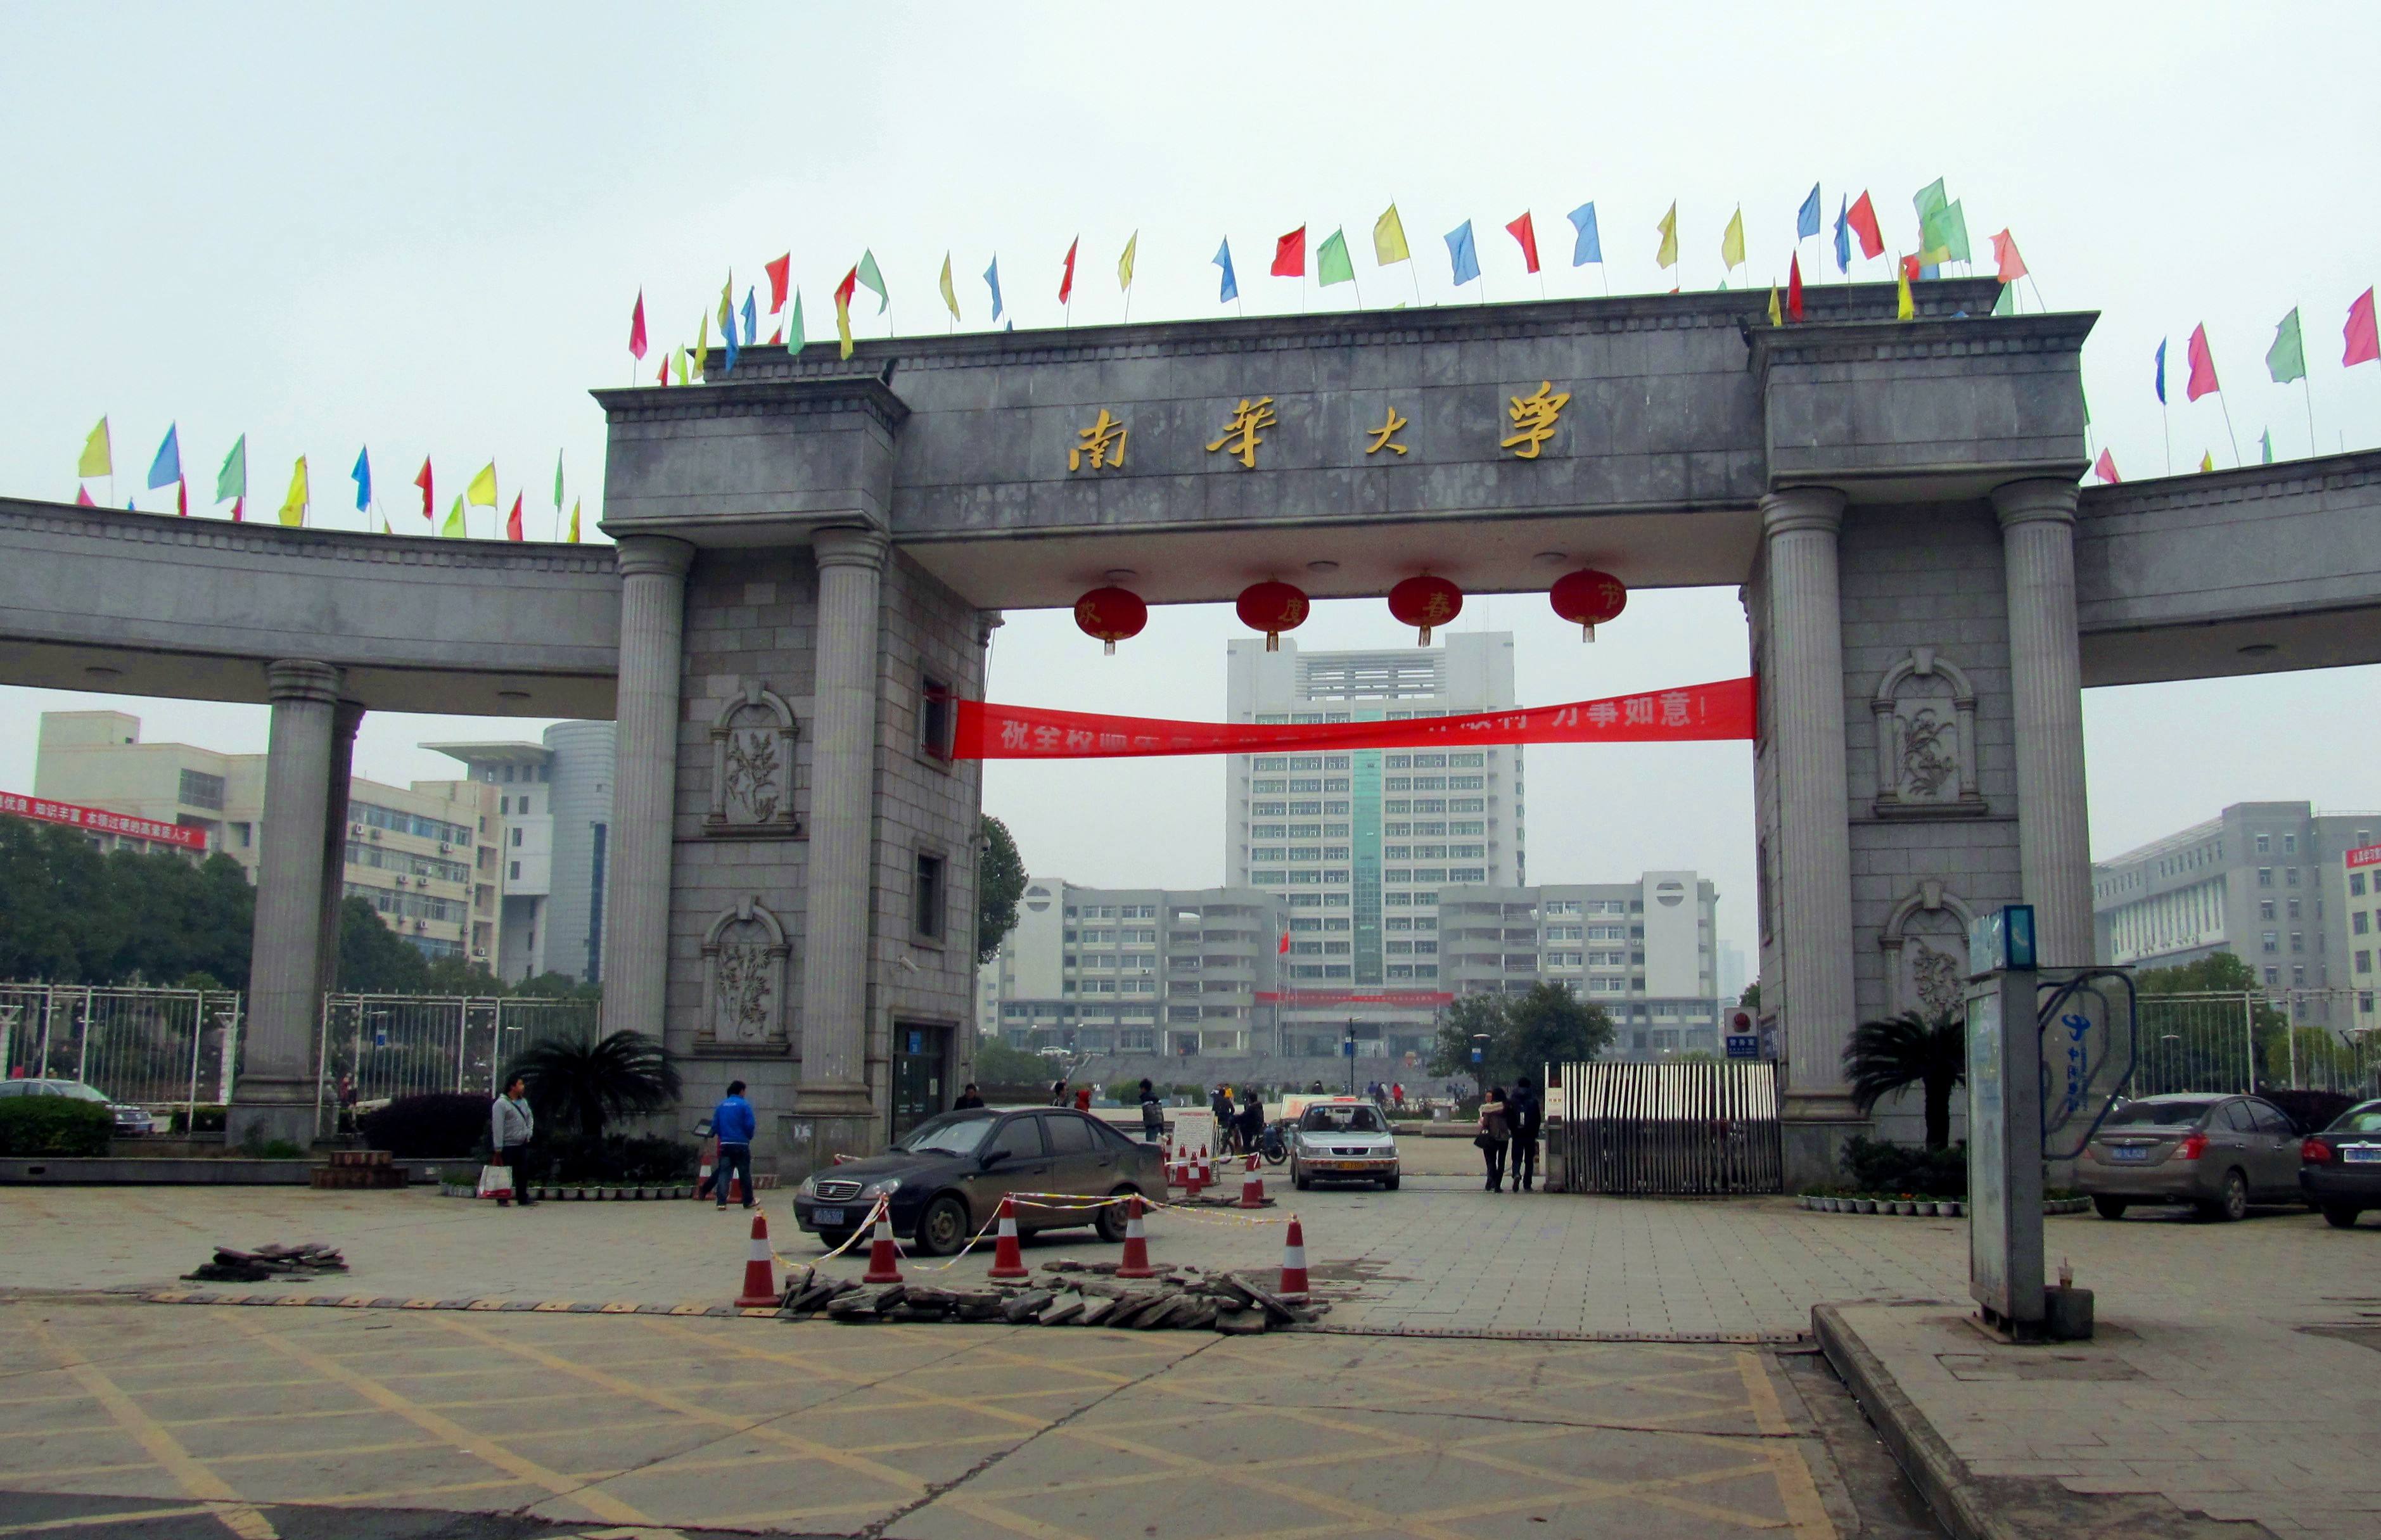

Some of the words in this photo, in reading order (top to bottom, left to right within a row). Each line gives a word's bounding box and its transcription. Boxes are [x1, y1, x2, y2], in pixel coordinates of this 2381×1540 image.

[1422, 591, 1452, 618] 春
[0, 795, 27, 811] 优良
[34, 803, 81, 822] 知识丰富
